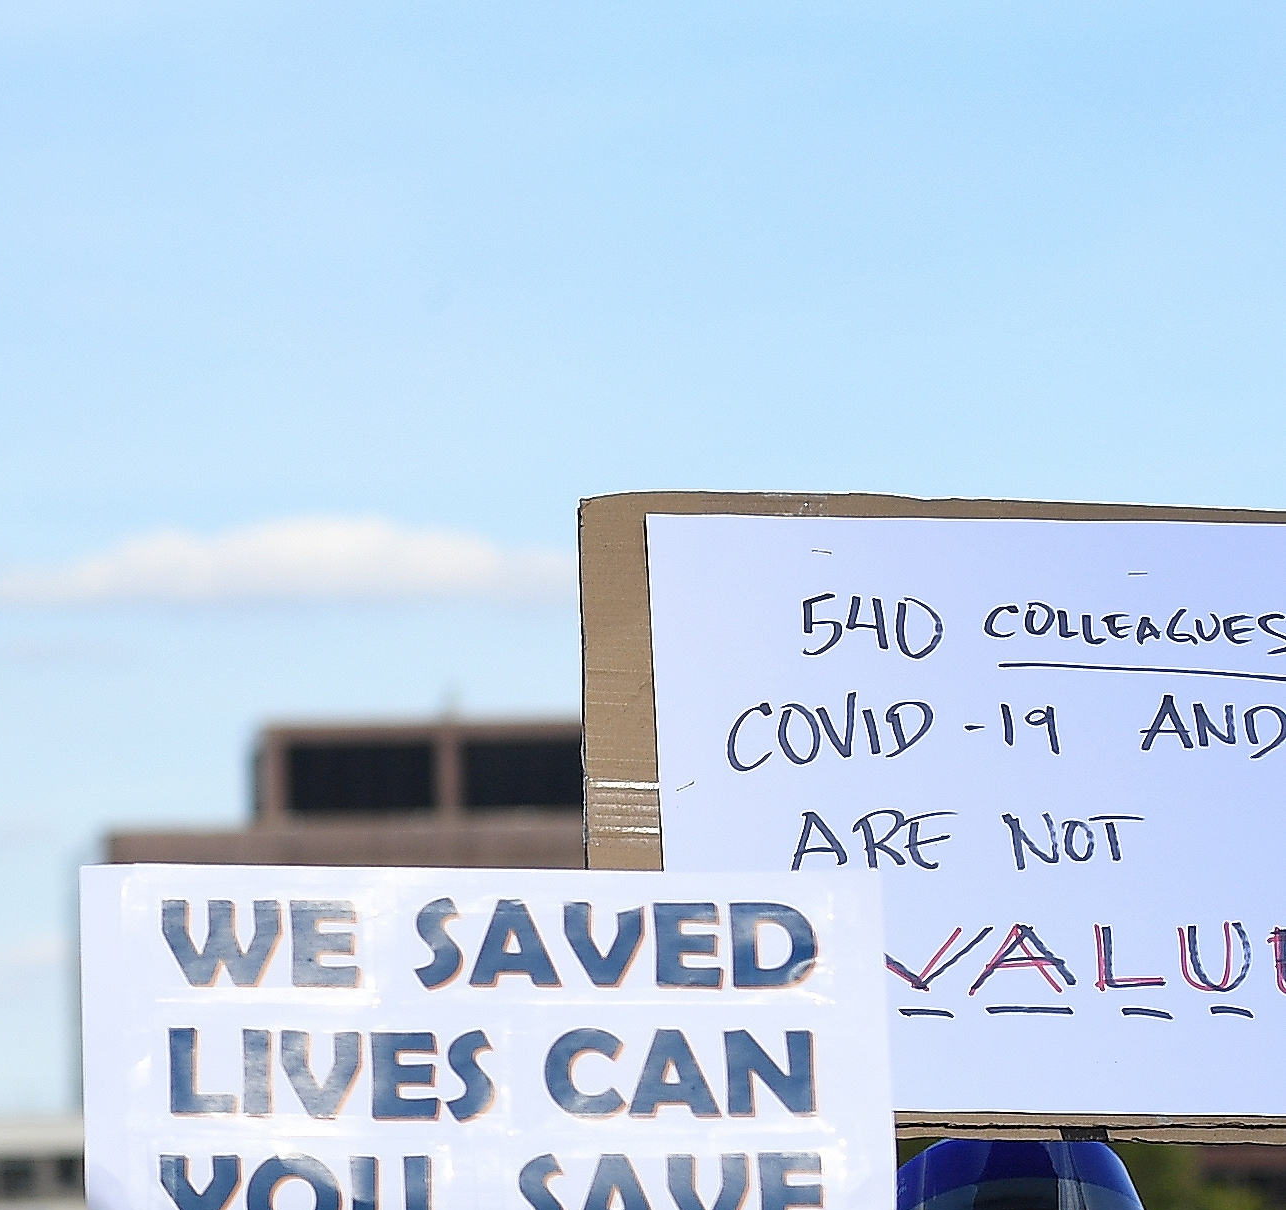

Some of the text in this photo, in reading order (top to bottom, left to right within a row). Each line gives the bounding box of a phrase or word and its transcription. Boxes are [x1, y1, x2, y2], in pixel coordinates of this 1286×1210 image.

[803, 593, 1286, 659] 540 COLLEAGUES
[1140, 695, 1286, 759] AND
[792, 810, 1145, 871] ARE NOT
[162, 897, 818, 990] WE SAVED
[885, 921, 1286, 997] VALU
[168, 1027, 816, 1122] LIVES CAN
